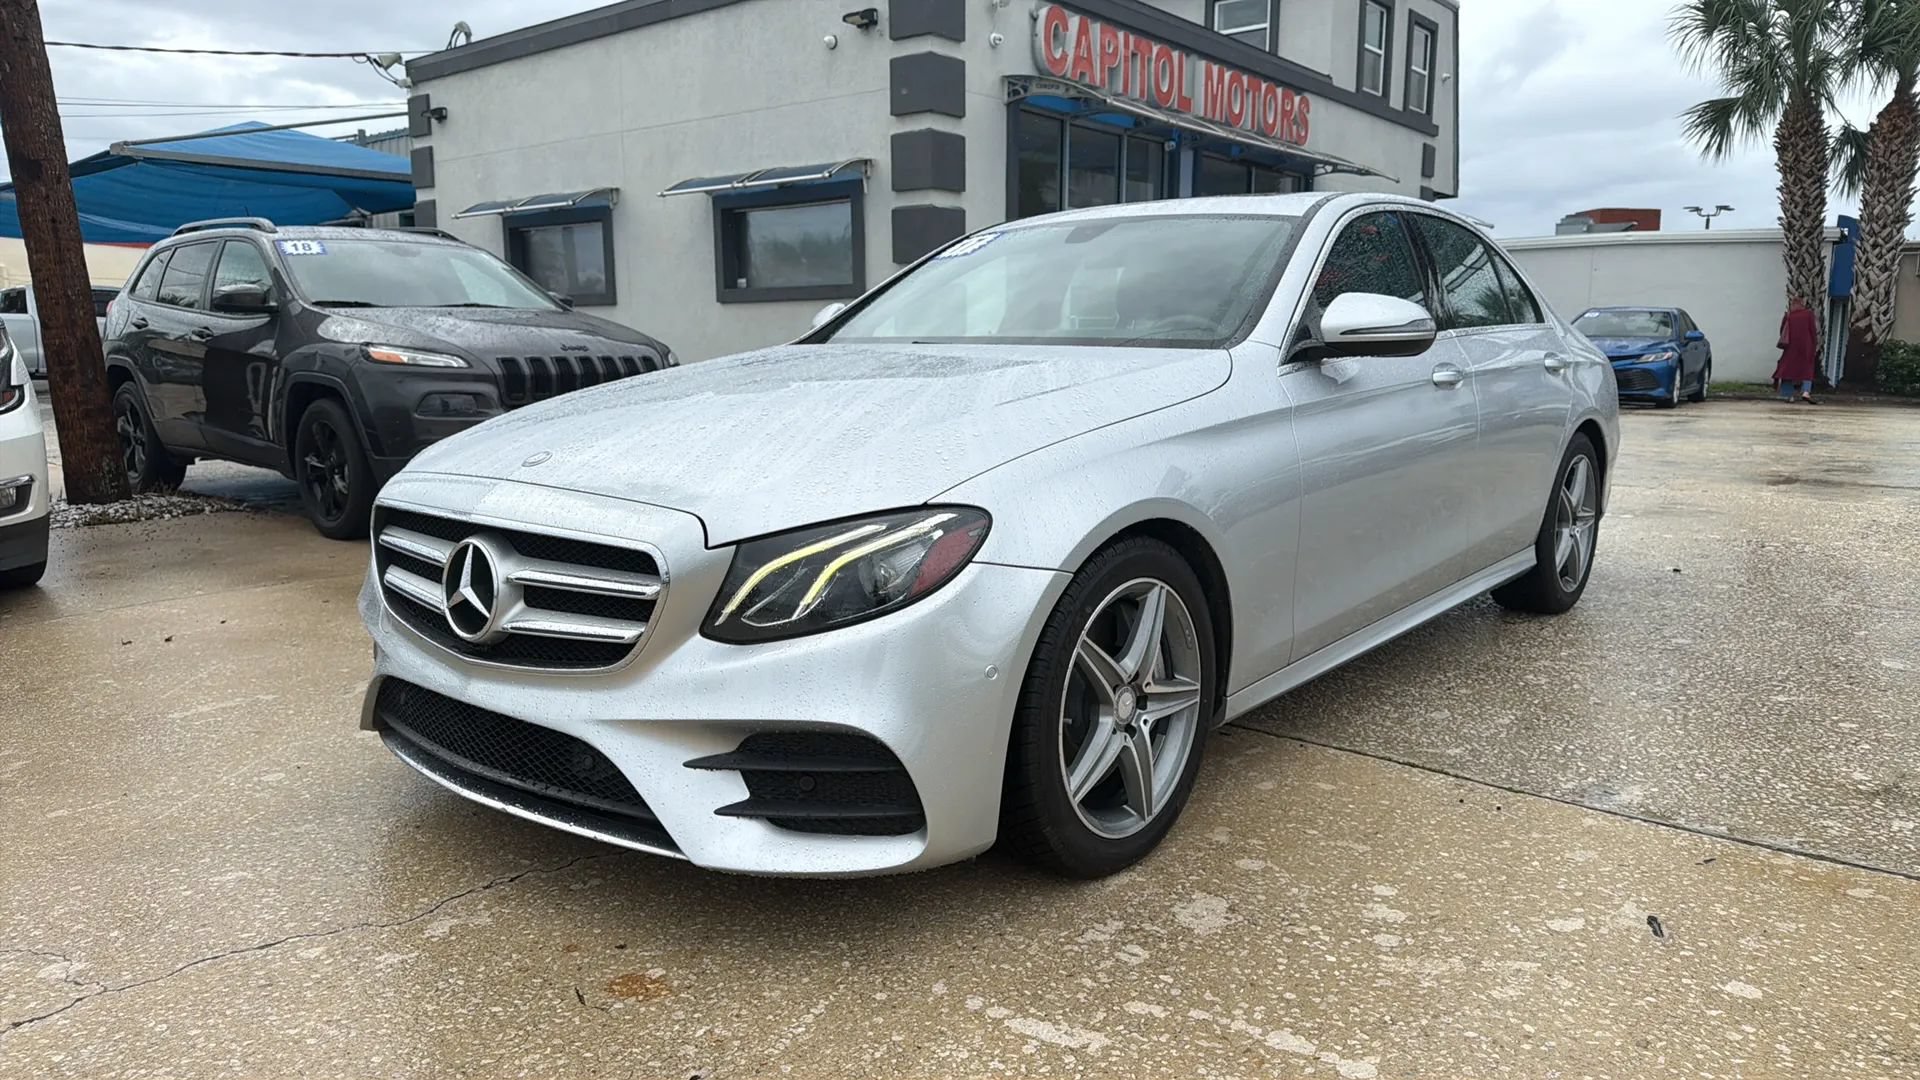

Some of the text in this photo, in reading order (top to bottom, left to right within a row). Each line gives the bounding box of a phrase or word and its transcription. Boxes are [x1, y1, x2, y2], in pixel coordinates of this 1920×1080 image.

[1043, 5, 1310, 146] CAPITOL MOTORS
[290, 242, 312, 252] 18
